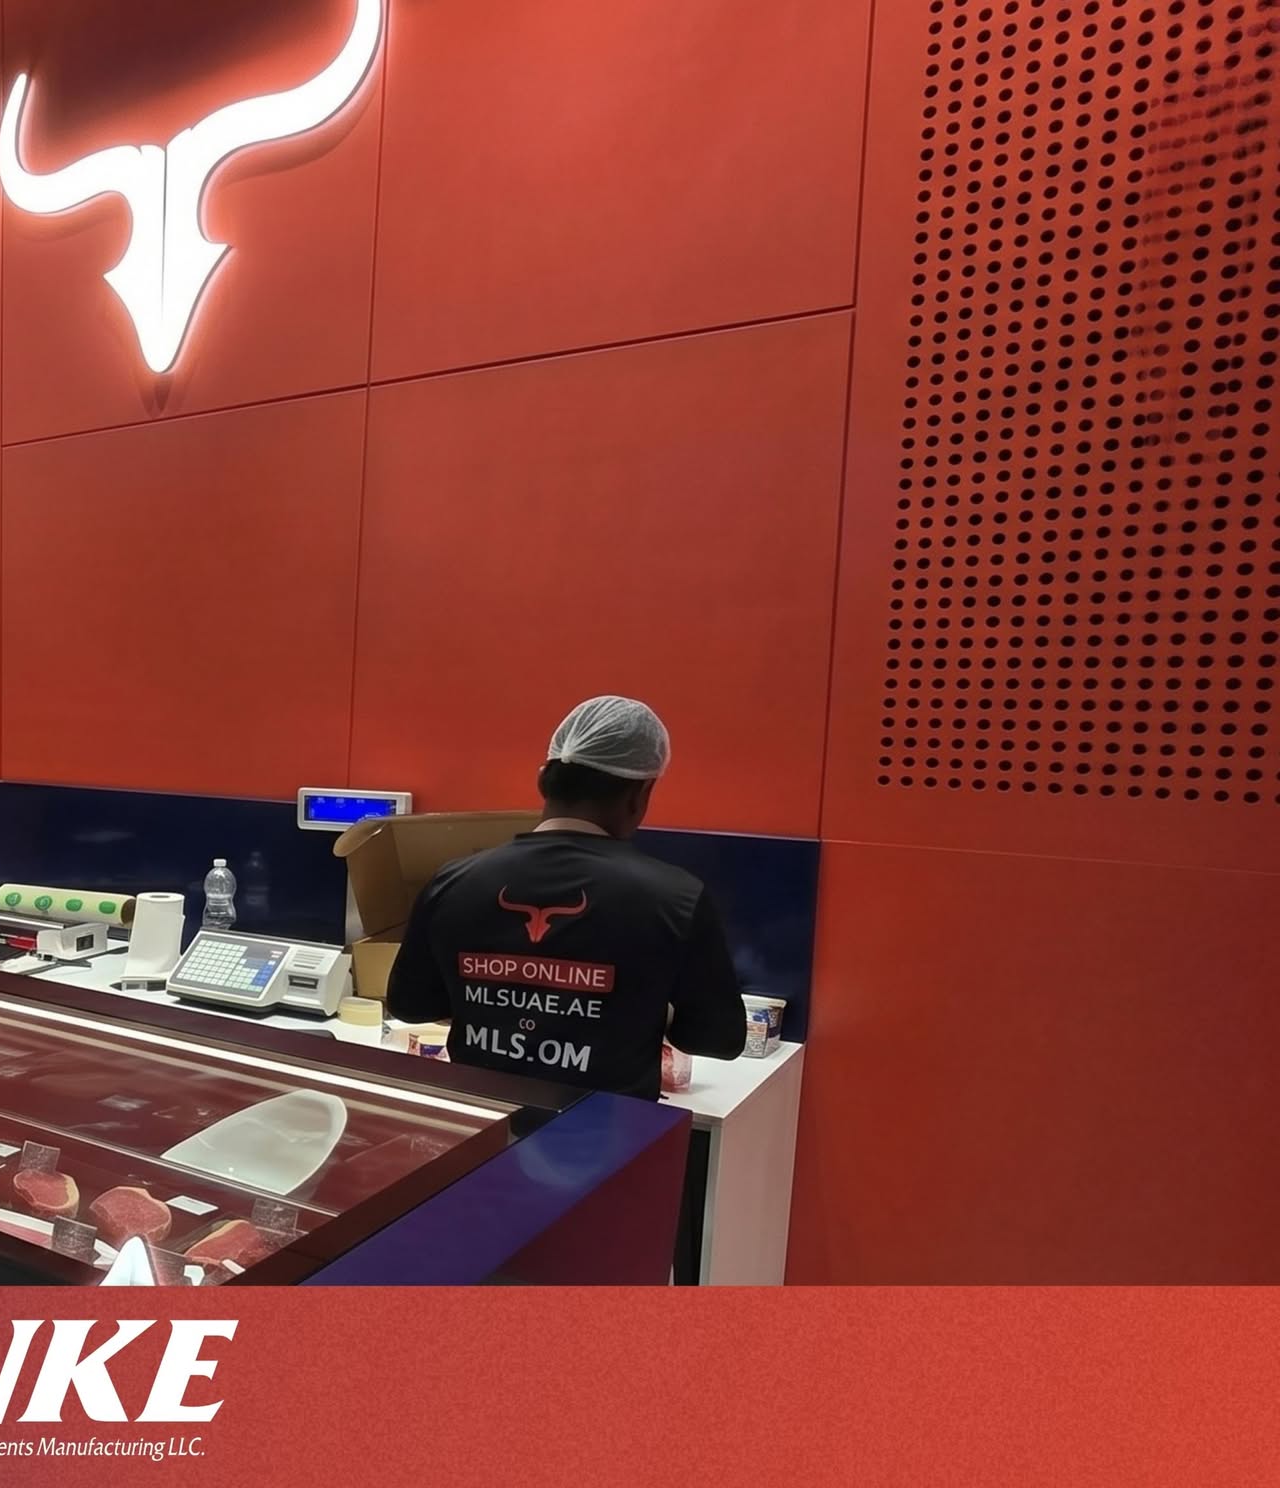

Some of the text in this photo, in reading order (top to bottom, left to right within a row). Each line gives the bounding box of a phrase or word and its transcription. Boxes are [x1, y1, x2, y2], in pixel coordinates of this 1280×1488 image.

[463, 957, 607, 987] SHOP ONLINE
[465, 985, 602, 1018] MLSUAE.AE
[466, 1024, 592, 1072] MLS.OM
